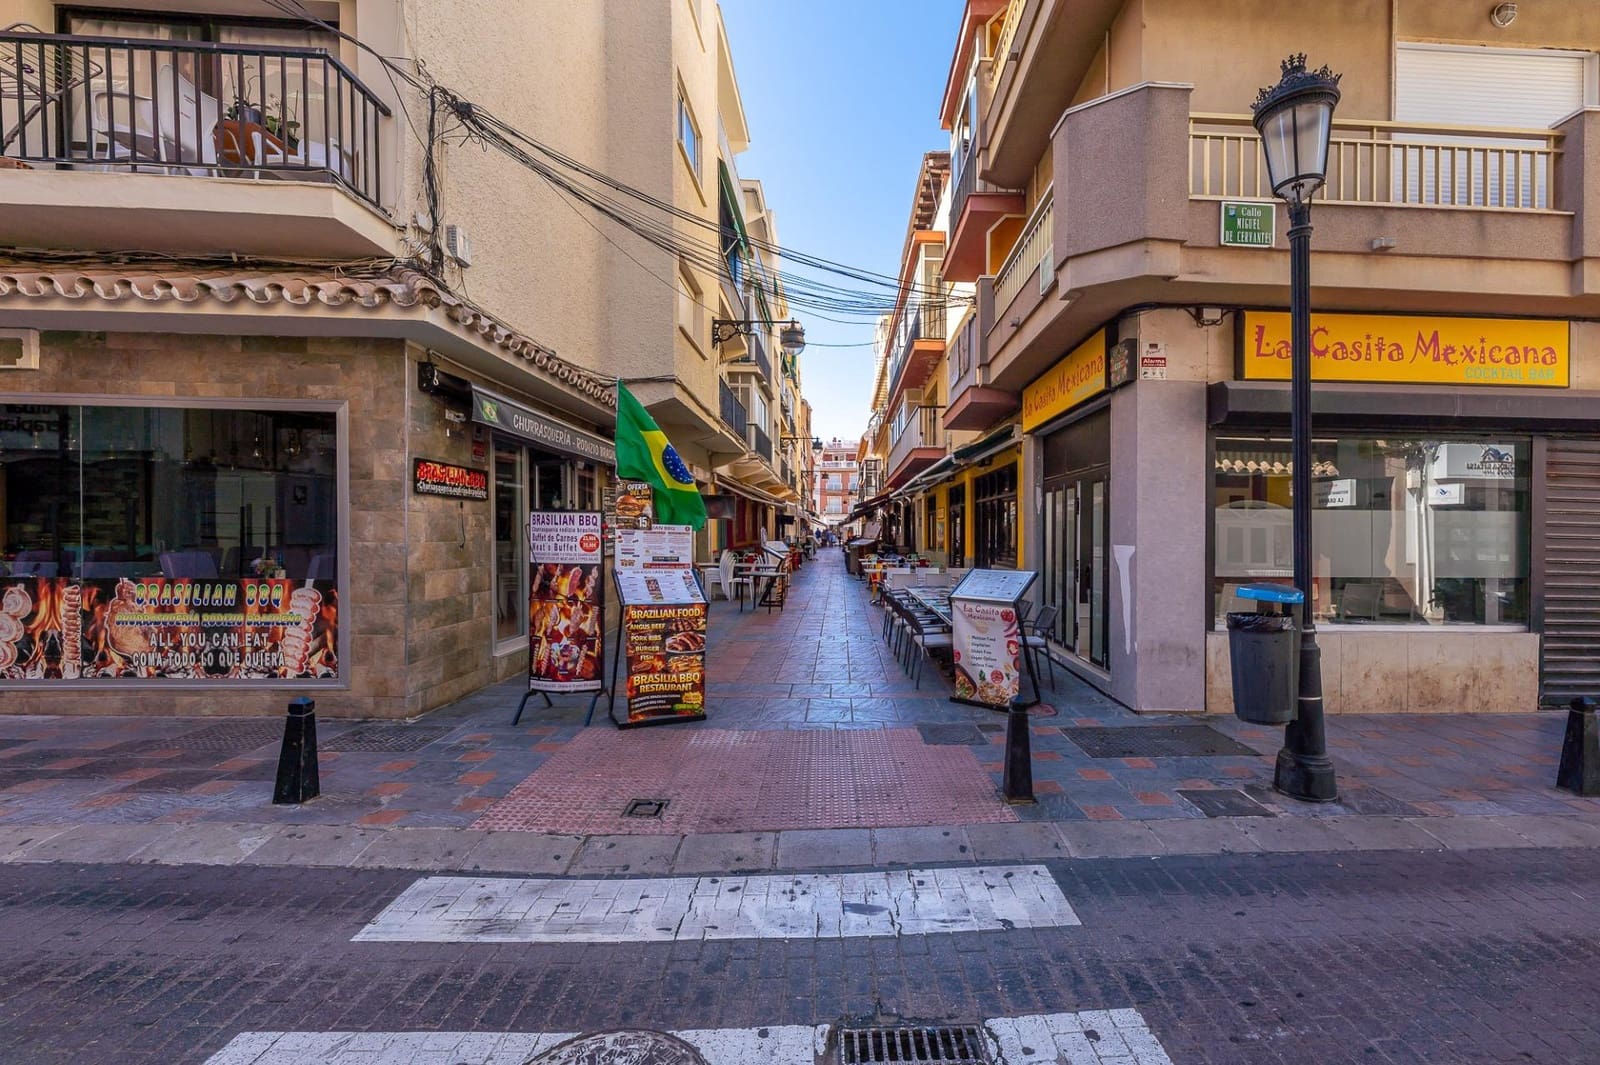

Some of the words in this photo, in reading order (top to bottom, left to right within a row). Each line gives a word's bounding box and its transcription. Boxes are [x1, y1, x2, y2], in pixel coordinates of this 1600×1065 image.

[1241, 207, 1262, 217] Calle
[1236, 217, 1261, 230] MIGUEL
[1224, 230, 1233, 242] DE
[1236, 231, 1272, 244] CERVANTES
[1254, 324, 1292, 360] La
[1310, 325, 1404, 362] Casita
[1408, 329, 1557, 367] Mexicana
[1464, 366, 1524, 380] COCKTAIL
[1528, 368, 1556, 381] BAR
[1024, 396, 1033, 418] La
[1034, 386, 1056, 411] Casita
[1058, 354, 1104, 396] Mexicana
[513, 414, 571, 446] CHURRASQUERÍA
[417, 462, 466, 486] BRASILIAN
[466, 472, 486, 490] BBQ
[532, 514, 575, 526] BRASILIAN
[579, 515, 598, 526] BBQ
[638, 516, 648, 528] 15
[532, 533, 546, 542] Buffet
[548, 533, 555, 542] de
[556, 533, 578, 542] Carnes
[554, 543, 577, 552] Buffet
[134, 583, 237, 608] BRASILIAN
[246, 584, 283, 608] BBQ
[631, 608, 675, 619] BRAZILIAN
[678, 608, 700, 617] FOOD
[975, 604, 1000, 616] Casita
[150, 632, 174, 647] ALL
[180, 632, 206, 646] YOU
[212, 632, 238, 646] CAN
[245, 632, 268, 647] EAT
[132, 652, 164, 666] COMA
[167, 652, 196, 666] TODO
[200, 652, 214, 666] LO
[218, 652, 240, 667] QUE
[245, 652, 285, 667] QUIERA
[634, 673, 678, 686] BRASILIA
[680, 672, 701, 683] BBQ
[640, 682, 694, 693] RESTAURANT
